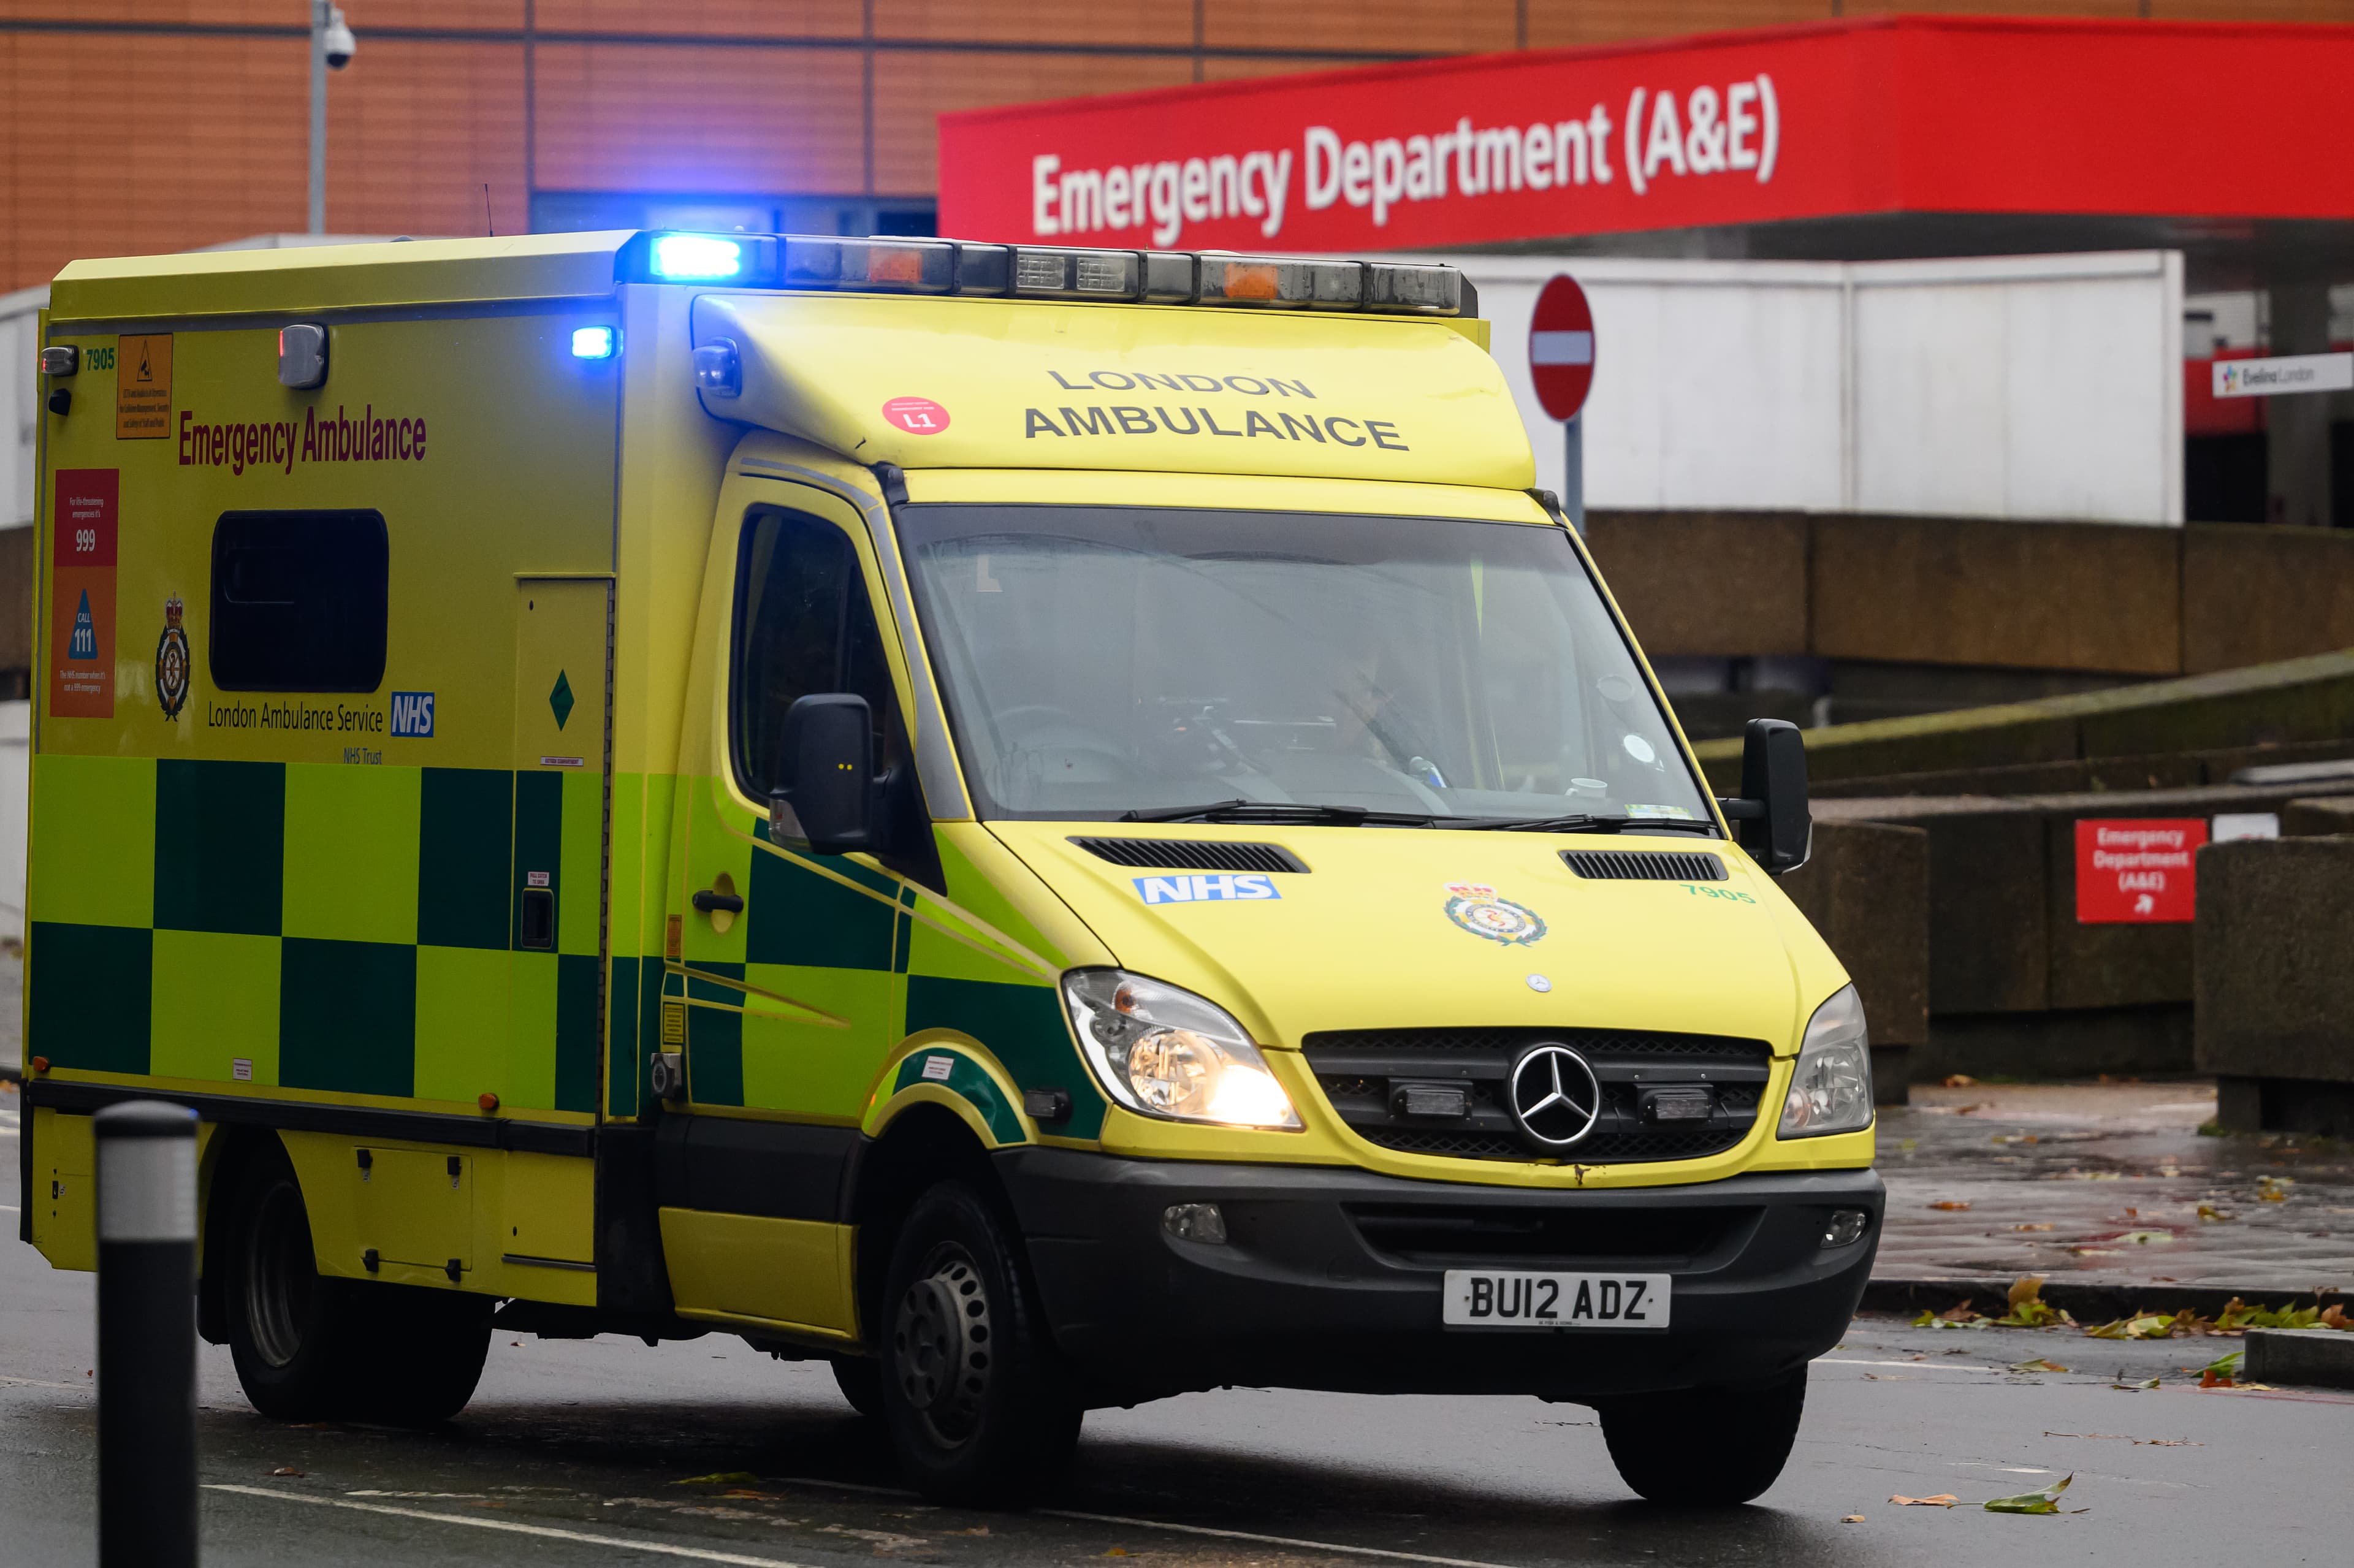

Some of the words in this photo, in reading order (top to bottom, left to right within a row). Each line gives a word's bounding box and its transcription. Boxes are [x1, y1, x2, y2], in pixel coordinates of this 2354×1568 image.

[1033, 148, 1293, 245] Emergency
[1304, 104, 1613, 226] Department
[1625, 74, 1778, 194] (A&E)
[86, 348, 115, 371] 7905
[1048, 371, 1318, 400] LONDON
[903, 413, 936, 427] L1
[1024, 406, 1410, 452] AMBULANCE
[179, 410, 297, 476] Emergency
[302, 405, 427, 463] Ambulance
[76, 529, 96, 552] 999
[78, 612, 91, 623] CALL
[75, 628, 92, 652] 111
[208, 700, 256, 728] London
[261, 701, 333, 731] Ambulance
[337, 704, 383, 733] Service
[391, 695, 433, 734] NHS
[343, 747, 360, 764] NHS
[362, 748, 382, 766] Trust
[2097, 828, 2185, 849] Emergency
[2093, 850, 2189, 870] Department
[1143, 875, 1273, 901] NHS
[1681, 883, 1757, 904] 7905
[2118, 872, 2166, 892] (A&E)
[1469, 1277, 1559, 1319] BU12
[1572, 1279, 1647, 1320] ADZ
